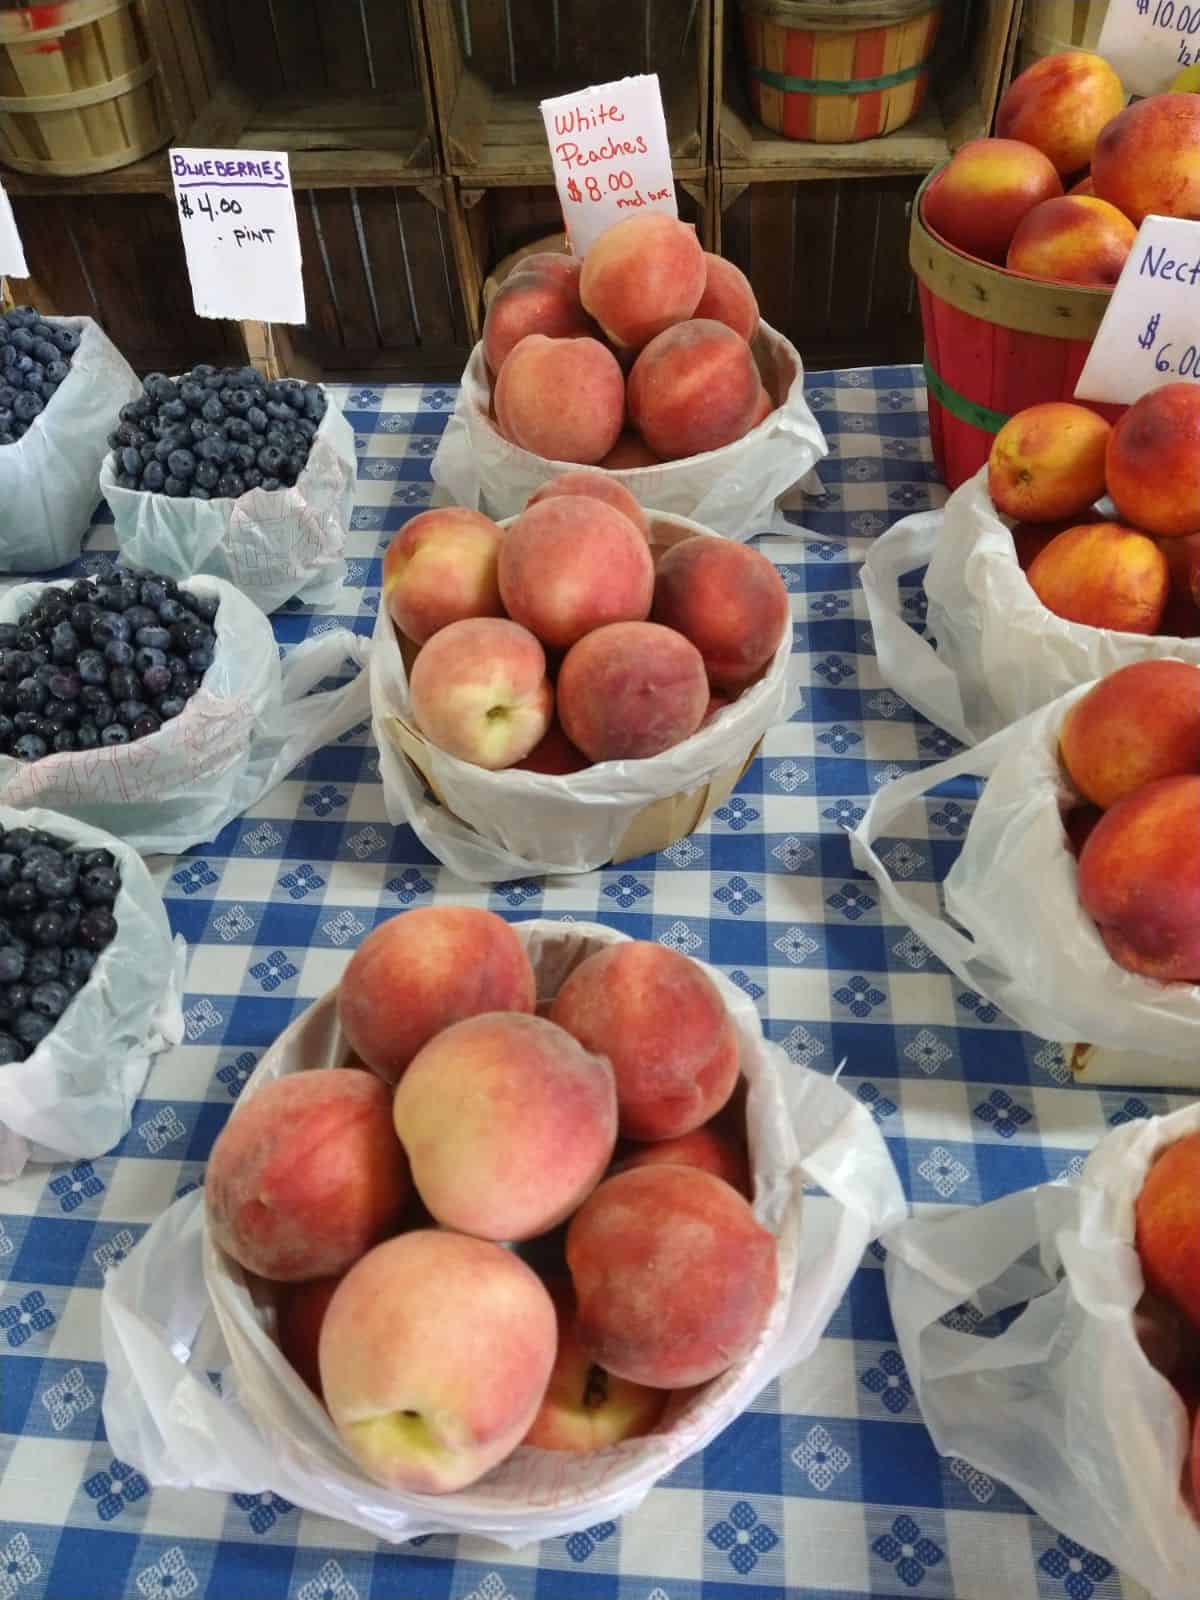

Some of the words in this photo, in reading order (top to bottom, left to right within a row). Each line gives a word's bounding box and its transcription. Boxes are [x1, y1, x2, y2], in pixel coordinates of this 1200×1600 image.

[555, 103, 624, 135] White
[172, 154, 284, 180] BLUEBERRIES
[556, 135, 648, 169] Peaches
[567, 170, 633, 203] $8.00
[180, 192, 242, 221] $4.00
